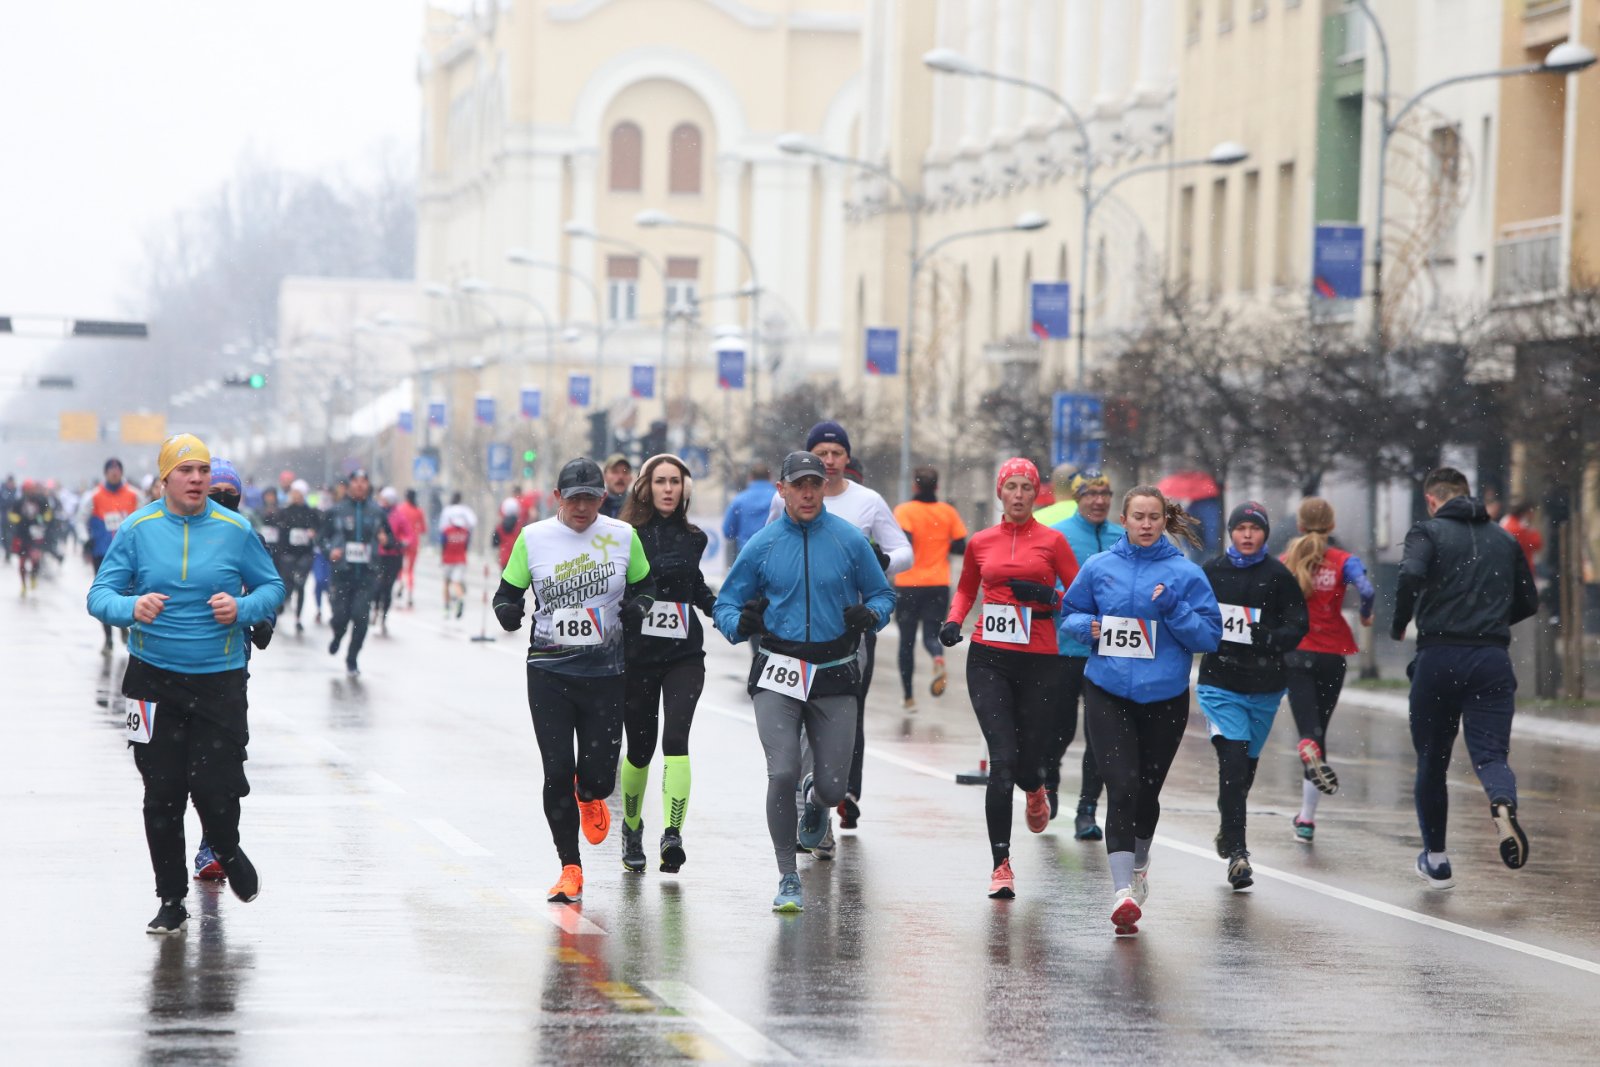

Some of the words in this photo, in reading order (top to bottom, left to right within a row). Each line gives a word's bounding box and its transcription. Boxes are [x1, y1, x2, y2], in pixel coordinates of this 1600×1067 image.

[556, 620, 592, 637] 188
[646, 611, 679, 629] 123
[985, 615, 1017, 634] 081
[1224, 616, 1244, 634] 41
[1103, 628, 1142, 649] 155
[766, 664, 800, 688] 189
[127, 712, 140, 731] 49
